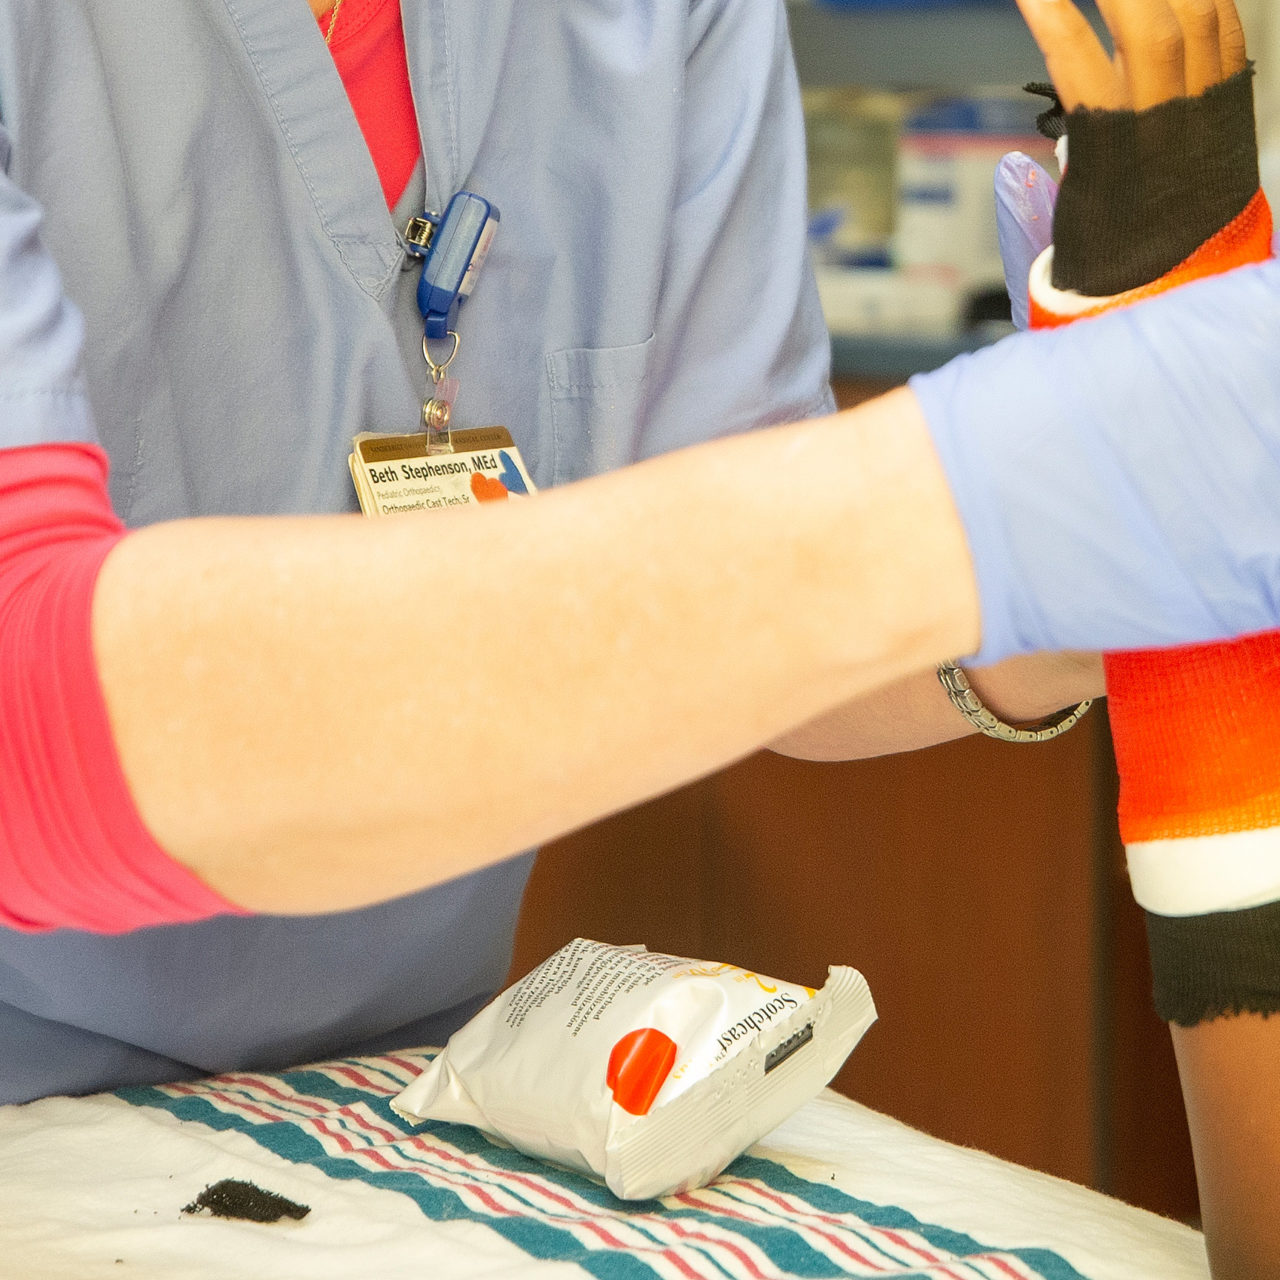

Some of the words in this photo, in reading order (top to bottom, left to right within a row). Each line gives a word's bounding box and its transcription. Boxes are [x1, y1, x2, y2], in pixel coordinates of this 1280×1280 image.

[369, 465, 398, 483] Beth
[401, 461, 472, 481] Stephenson,
[471, 454, 498, 471] MEd
[426, 498, 442, 509] Cast
